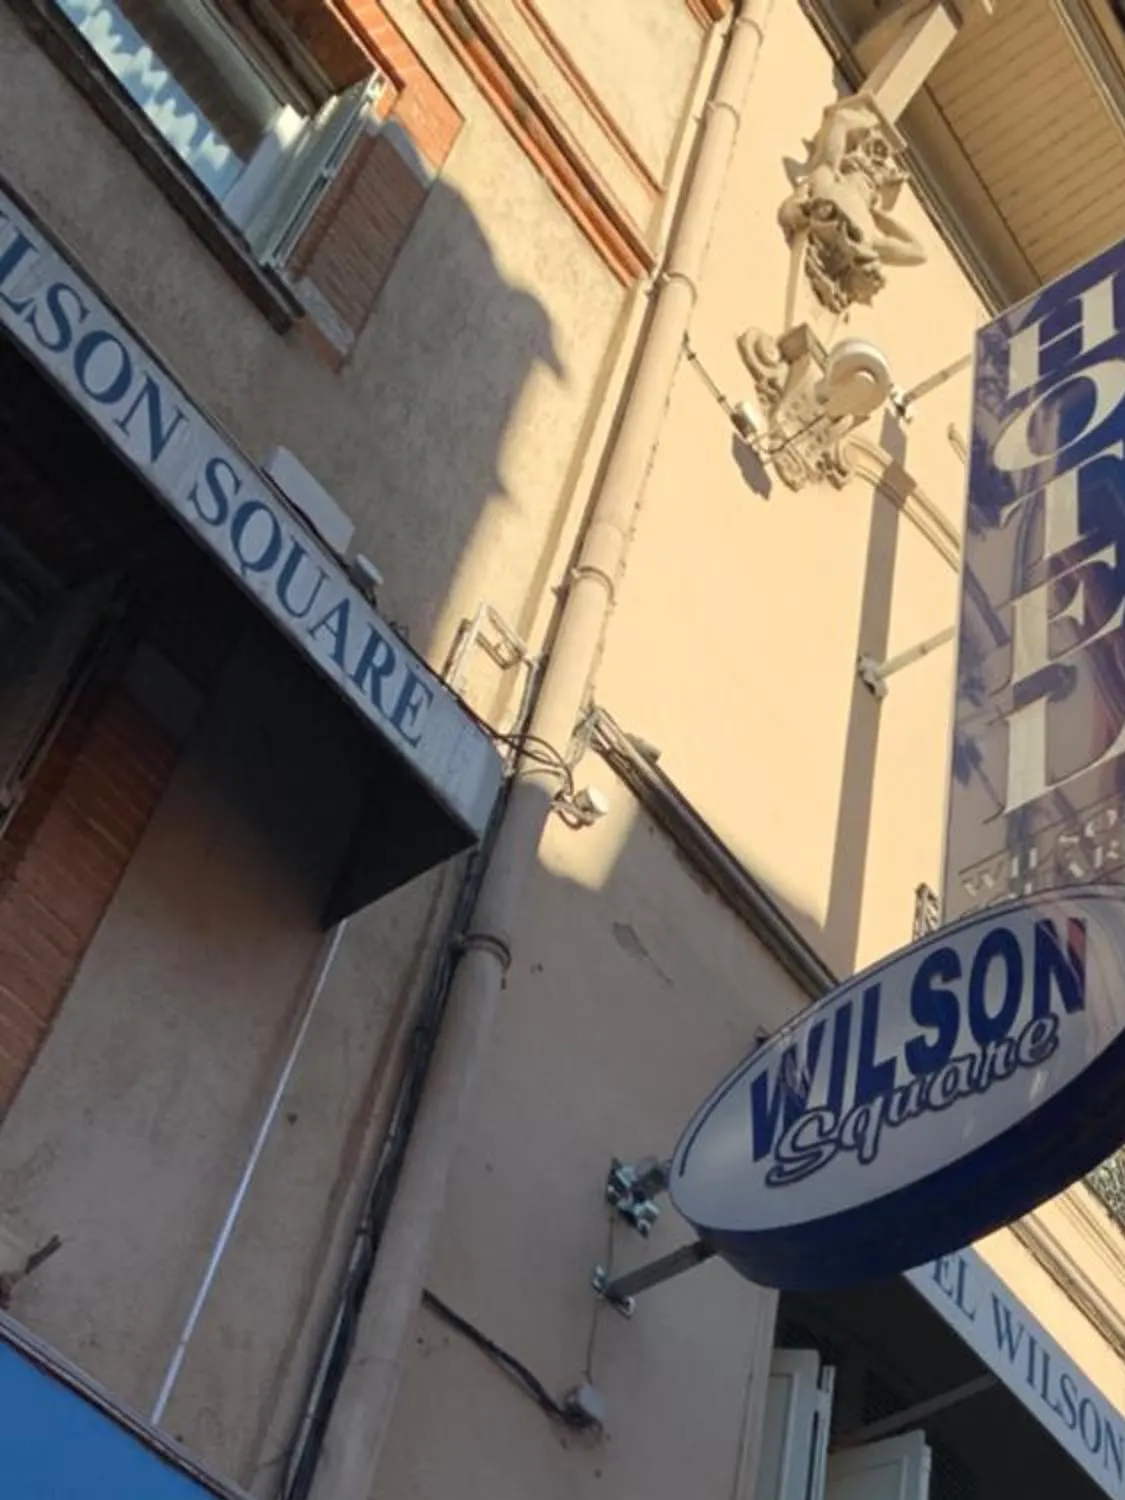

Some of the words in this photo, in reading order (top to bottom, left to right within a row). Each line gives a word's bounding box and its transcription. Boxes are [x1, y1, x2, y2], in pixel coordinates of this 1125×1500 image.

[0, 212, 189, 462] LSON
[188, 456, 435, 749] SQUARE
[751, 917, 1087, 1163] WILSON
[765, 1012, 1060, 1188] Square
